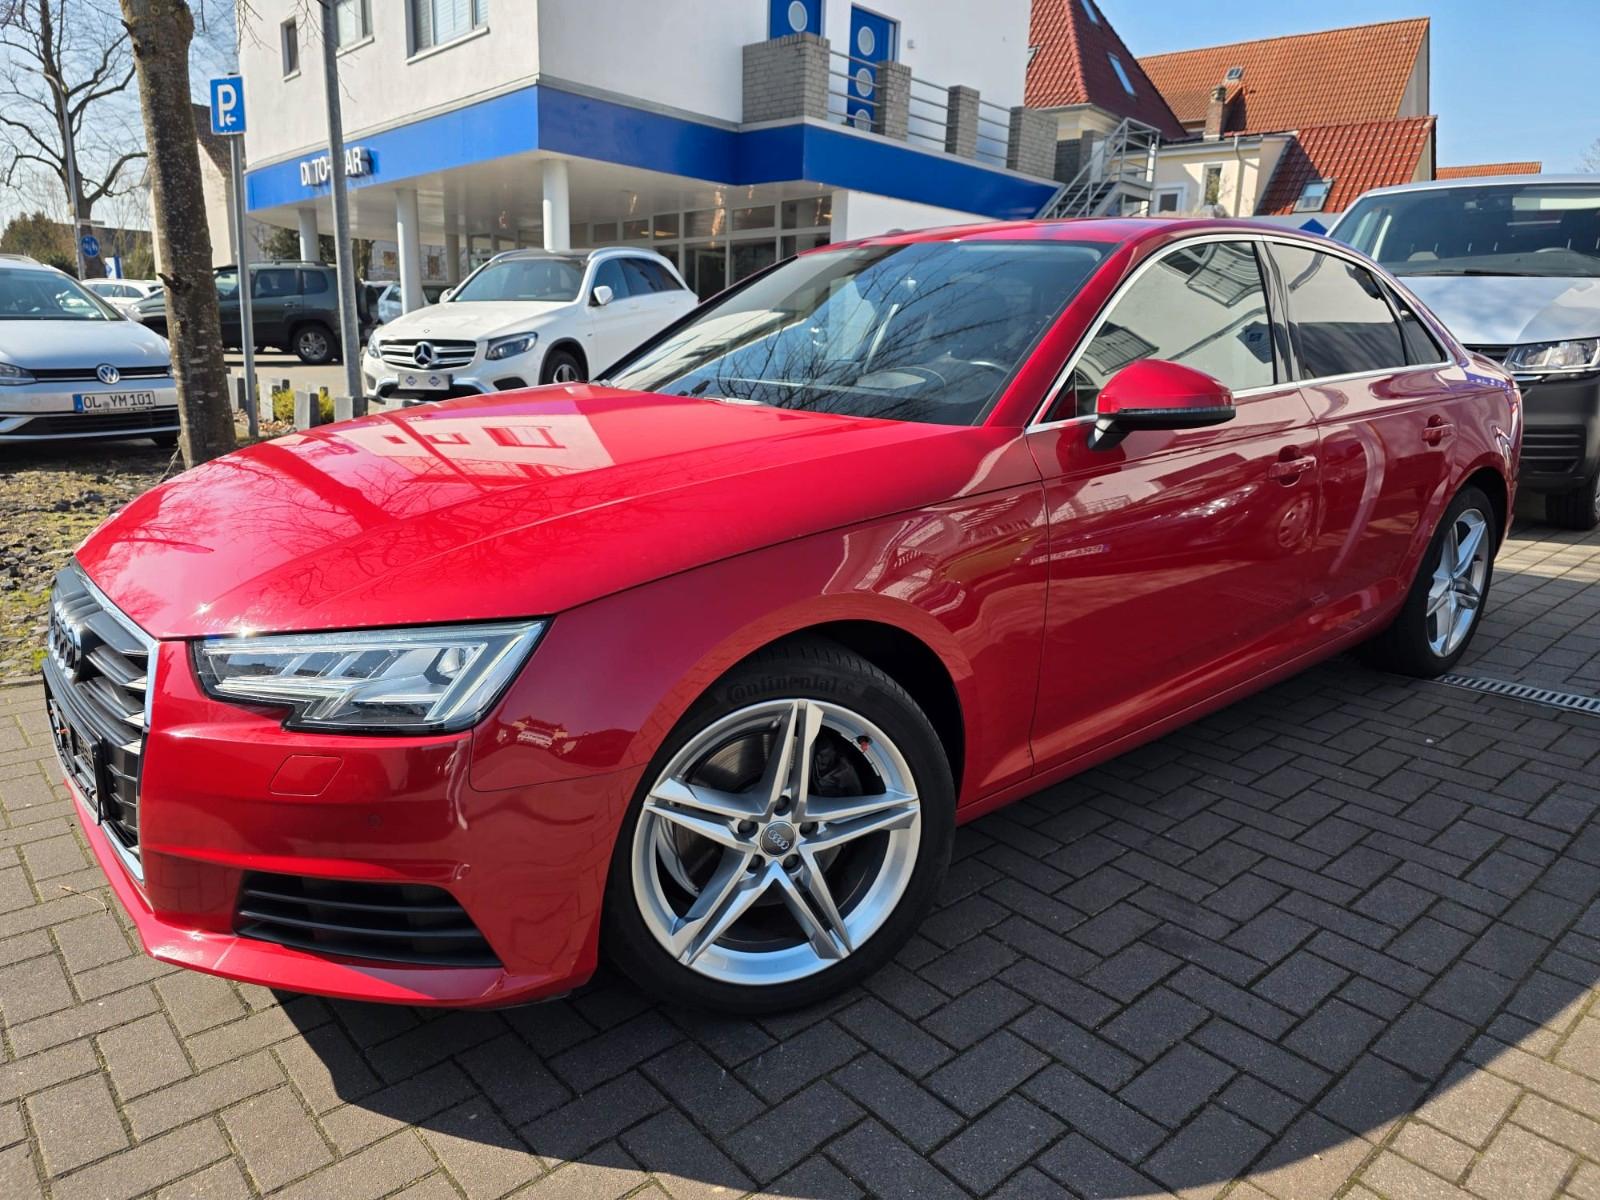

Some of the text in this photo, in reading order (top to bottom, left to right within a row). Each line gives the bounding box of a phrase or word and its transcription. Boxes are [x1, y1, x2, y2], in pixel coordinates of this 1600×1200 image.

[217, 84, 237, 127] P
[83, 393, 153, 409] OL YM 101
[726, 674, 838, 702] Continental
